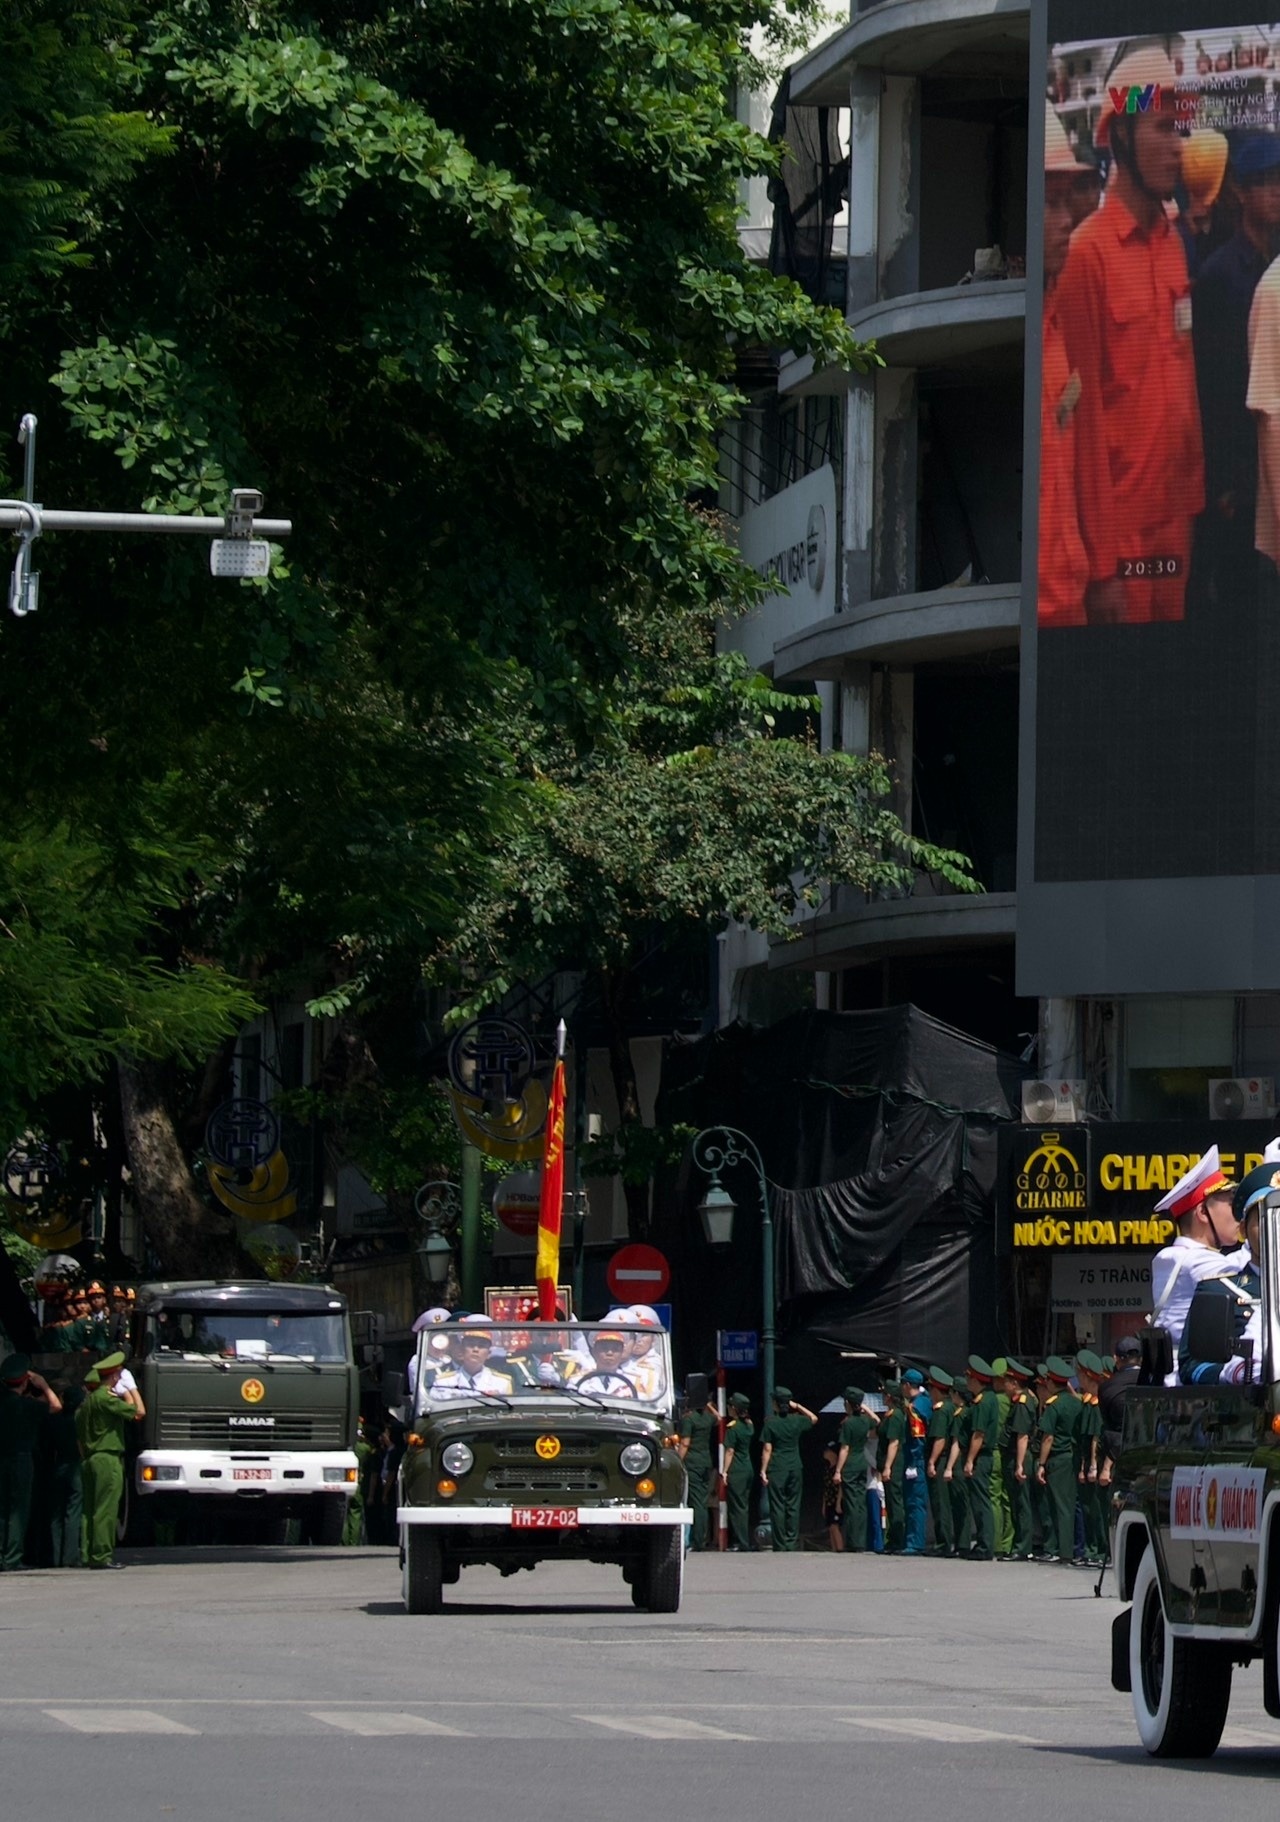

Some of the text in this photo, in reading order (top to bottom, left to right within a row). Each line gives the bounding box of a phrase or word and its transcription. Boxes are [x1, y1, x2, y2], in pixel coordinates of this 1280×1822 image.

[1124, 560, 1176, 576] 20:30
[1101, 1153, 1236, 1191] CHARE
[1016, 1190, 1086, 1209] CHARME
[1013, 1214, 1072, 1247] NƯỚC
[1074, 1219, 1118, 1246] HOA
[1119, 1214, 1174, 1246] PHÁP
[1079, 1269, 1095, 1284] 75
[228, 1416, 276, 1427] KAMAZ
[513, 1509, 578, 1526] TM-27-02
